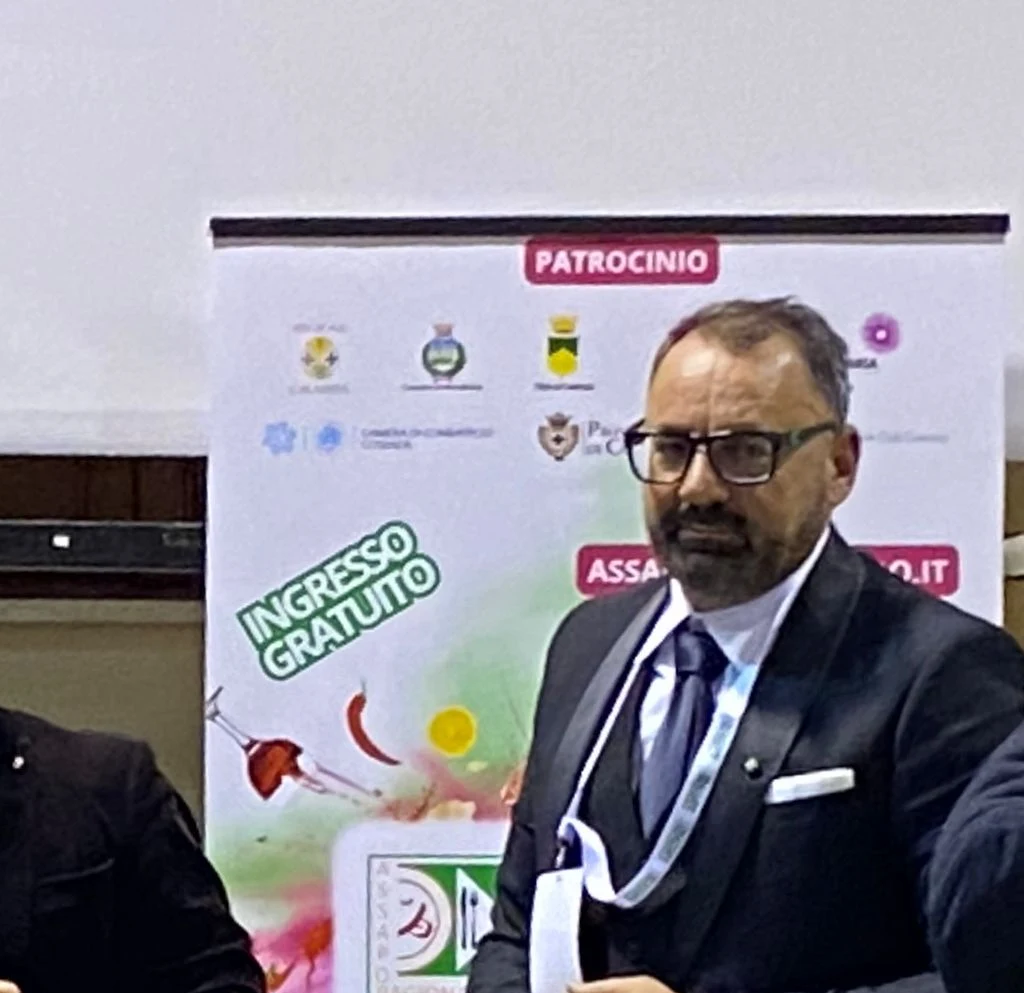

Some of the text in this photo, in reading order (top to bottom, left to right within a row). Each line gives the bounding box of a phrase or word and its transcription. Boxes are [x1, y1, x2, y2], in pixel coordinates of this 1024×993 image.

[535, 250, 709, 274] PATROCINIO
[242, 524, 414, 644] INGRESSO
[585, 558, 669, 584] ASSA
[882, 558, 950, 585] O.IT
[263, 557, 437, 678] GRATUITO
